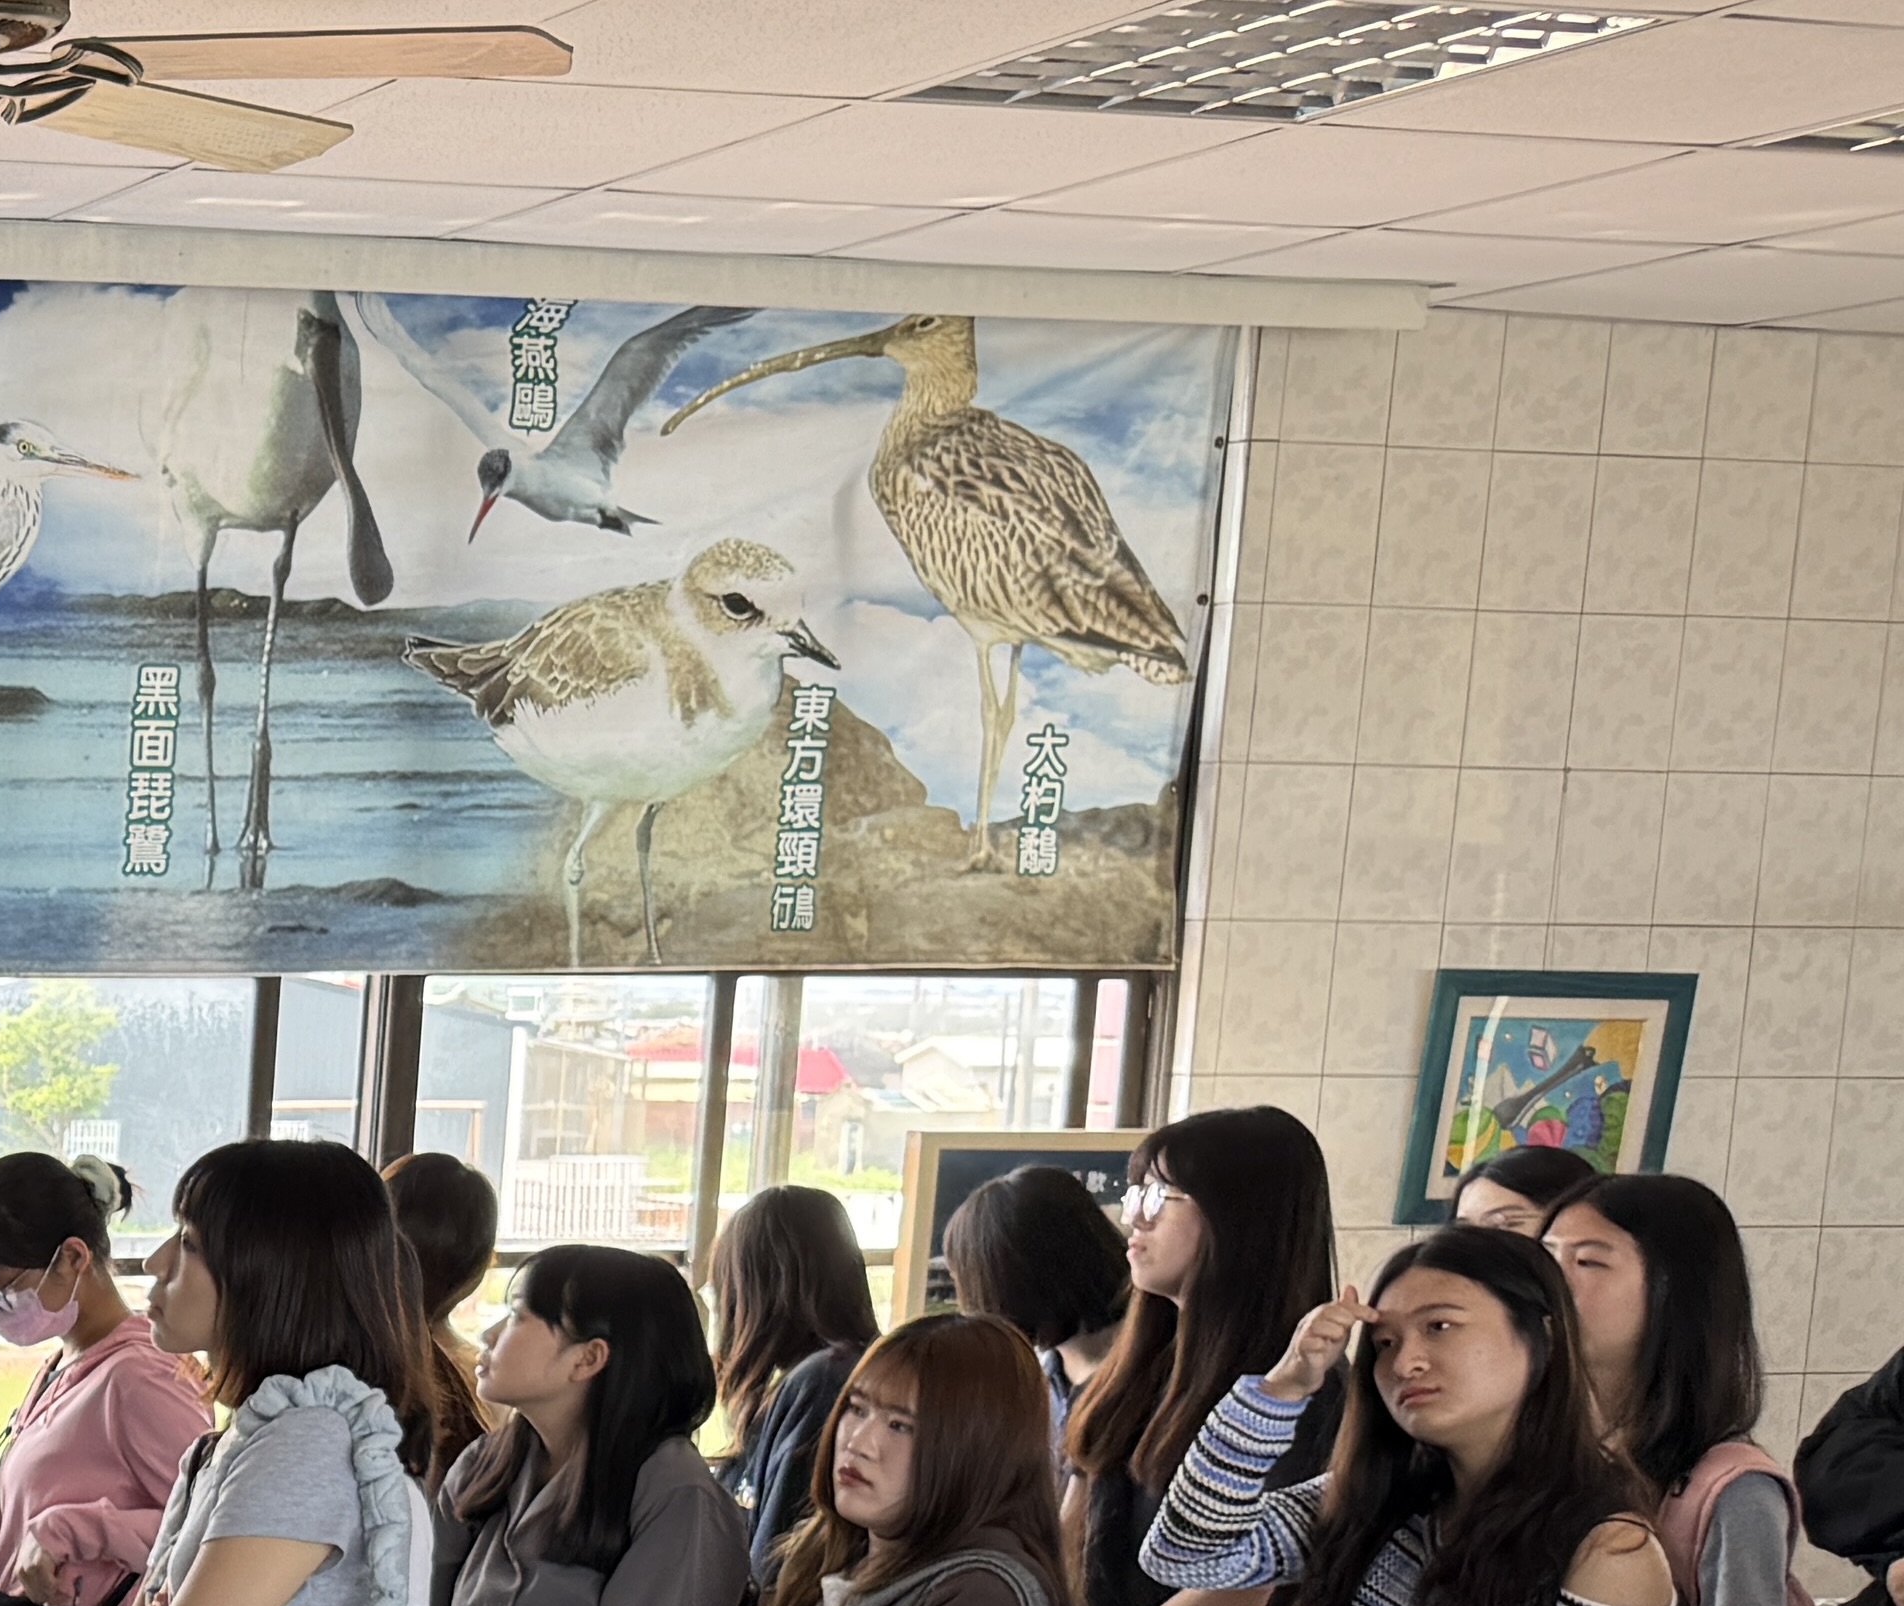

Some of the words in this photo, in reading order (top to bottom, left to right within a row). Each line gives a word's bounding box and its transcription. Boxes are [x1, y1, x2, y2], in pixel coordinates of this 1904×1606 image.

[124, 664, 180, 876] 黑面琵鷺
[772, 687, 835, 931] 東方環頸鴴
[1018, 725, 1069, 876] 大杓鷸
